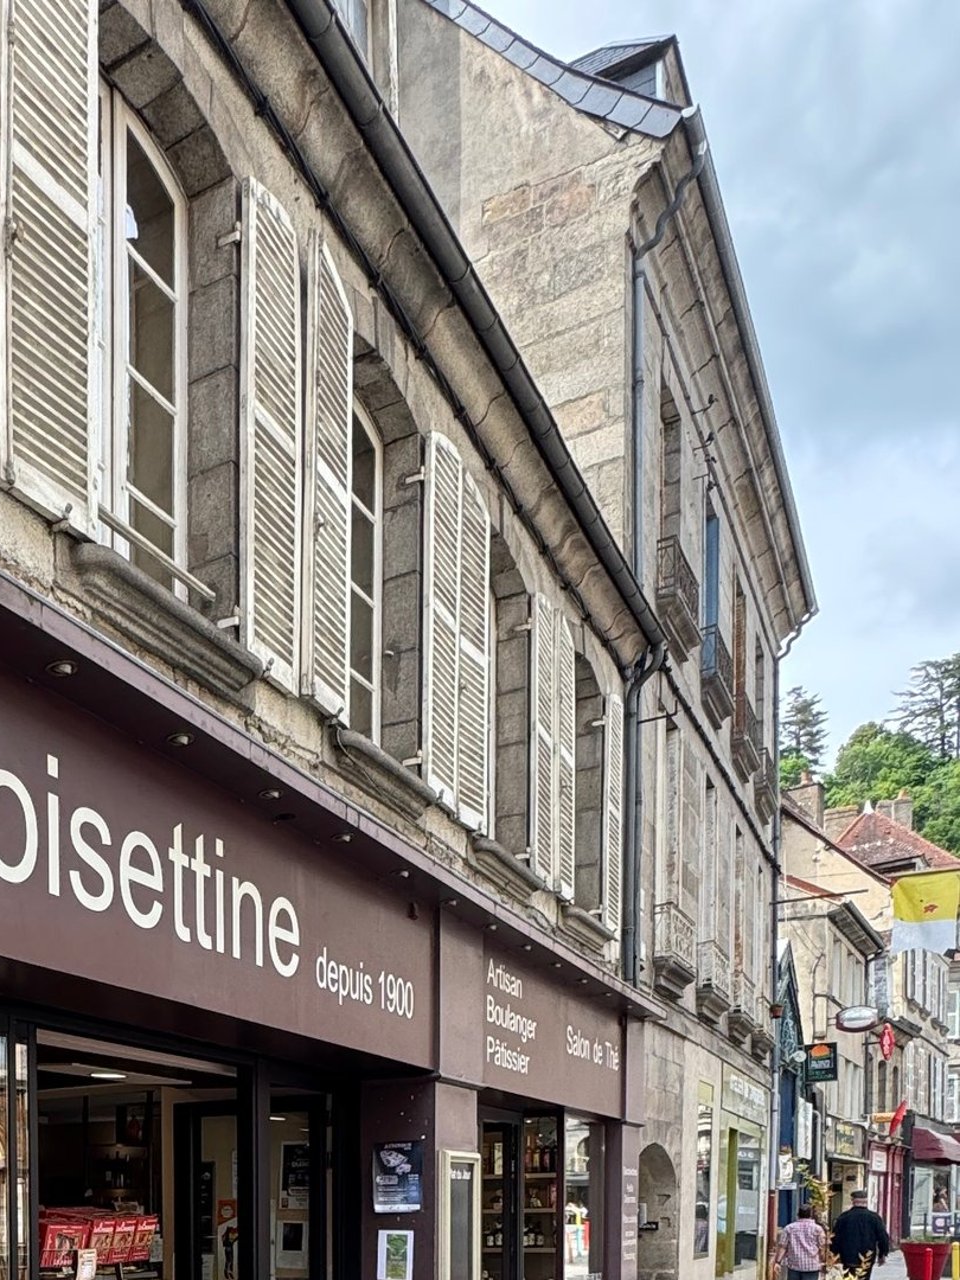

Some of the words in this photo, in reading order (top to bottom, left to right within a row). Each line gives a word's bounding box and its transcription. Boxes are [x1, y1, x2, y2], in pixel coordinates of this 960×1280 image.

[316, 946, 373, 1006] depuis
[378, 970, 414, 1020] 1900
[486, 958, 523, 999] Artisan
[486, 995, 538, 1043] Boulanger
[486, 1036, 531, 1075] Pâtissier
[566, 1025, 590, 1061] Salon
[593, 1037, 603, 1065] de
[605, 1041, 620, 1071] Thé
